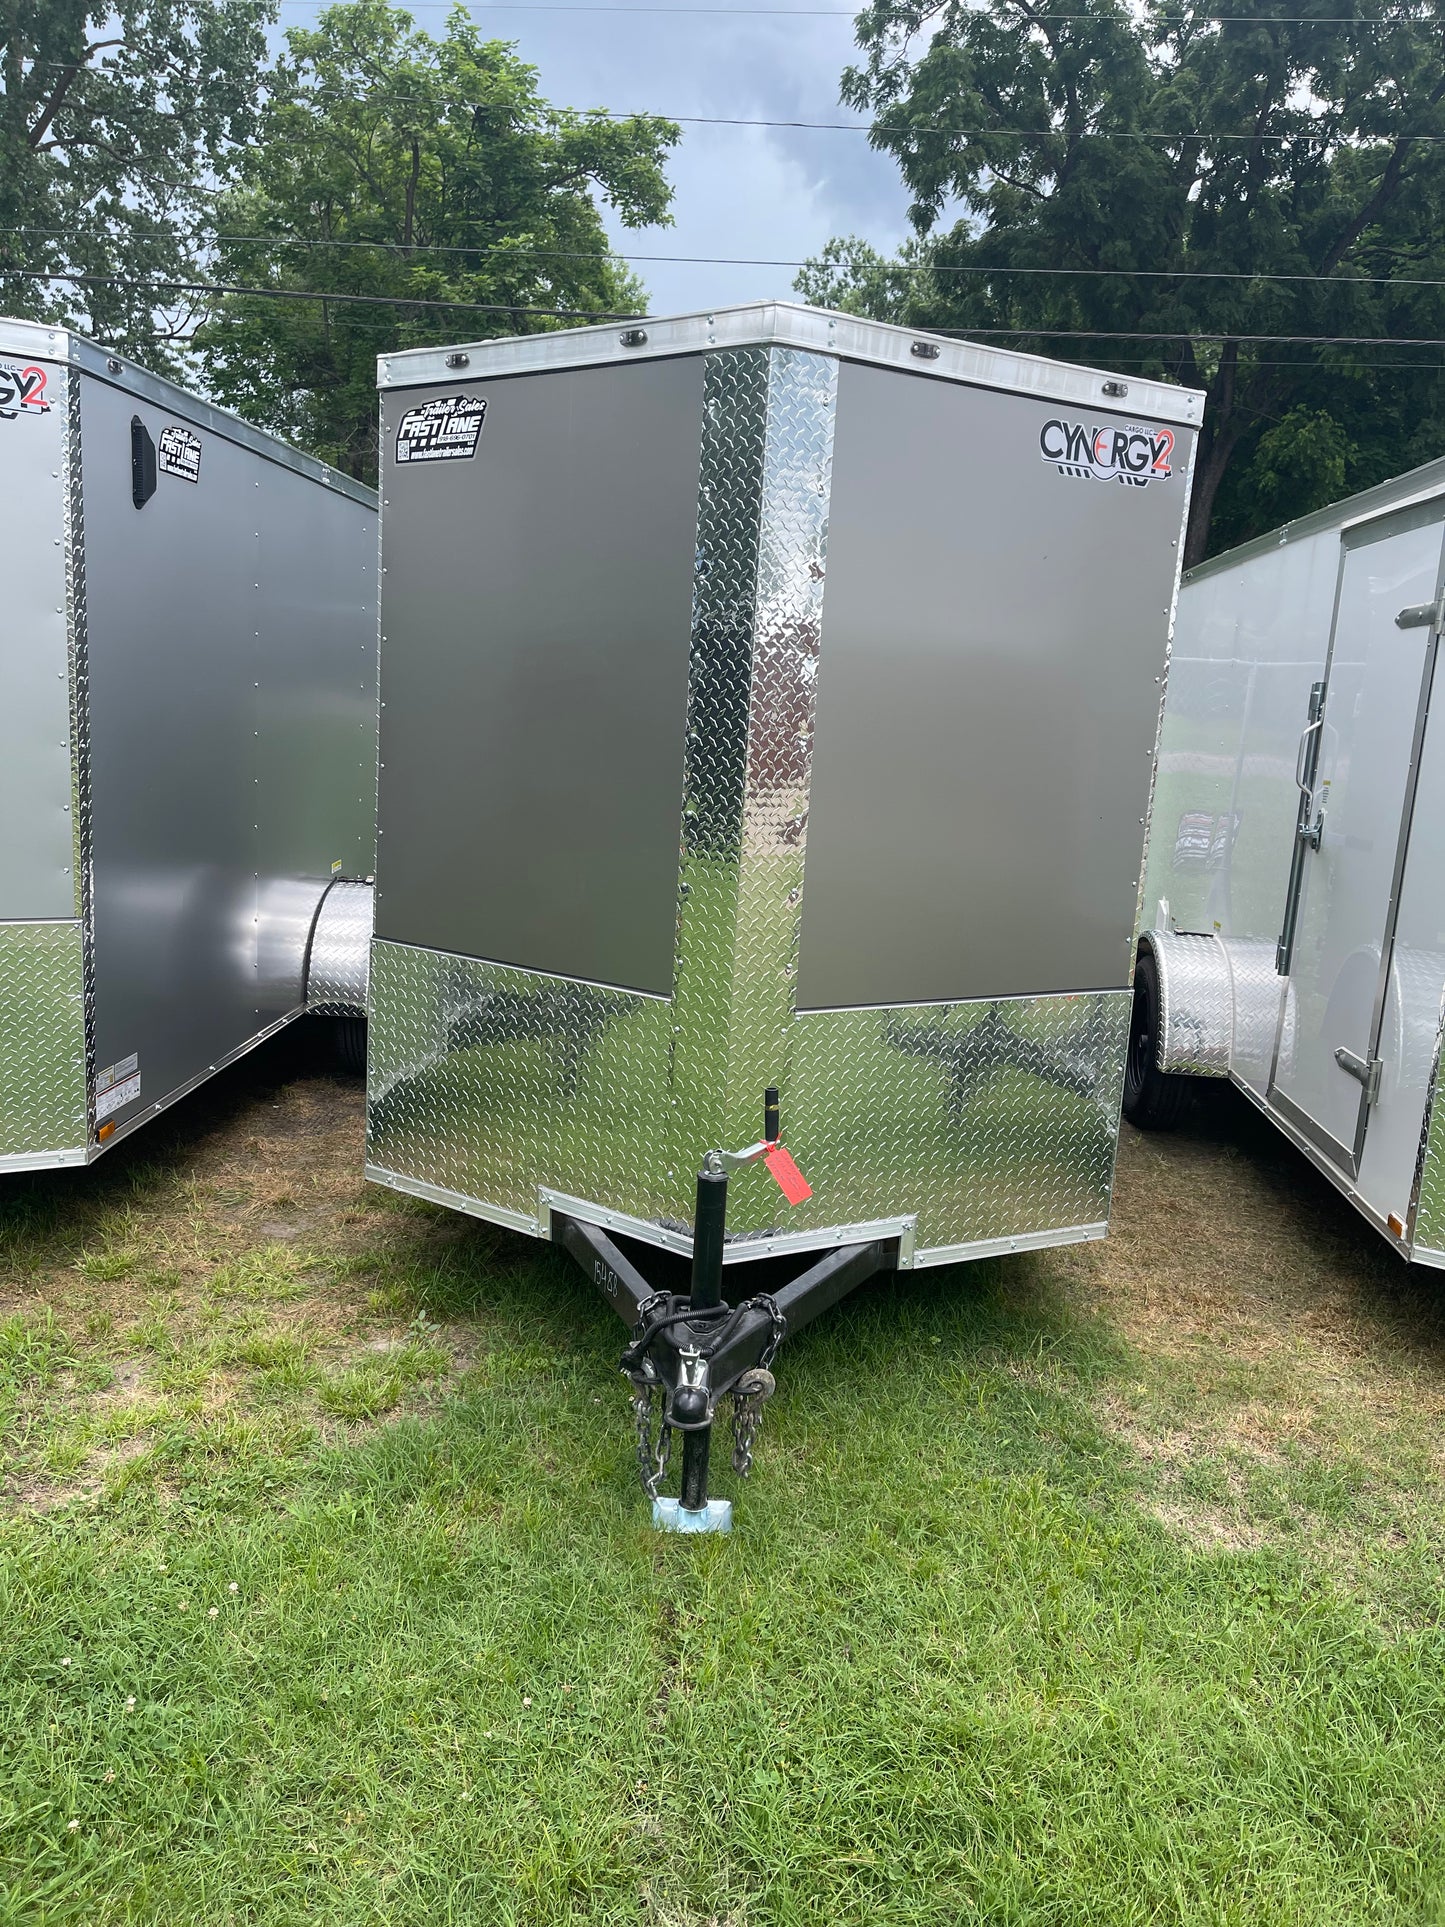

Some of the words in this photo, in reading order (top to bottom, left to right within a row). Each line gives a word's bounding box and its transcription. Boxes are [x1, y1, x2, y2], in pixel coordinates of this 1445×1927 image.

[422, 402, 457, 418] Trailer
[457, 399, 486, 414] Sales
[399, 415, 442, 439] FAST
[438, 415, 482, 438] LANE
[1124, 425, 1143, 434] CARGO
[160, 433, 183, 457] FAST
